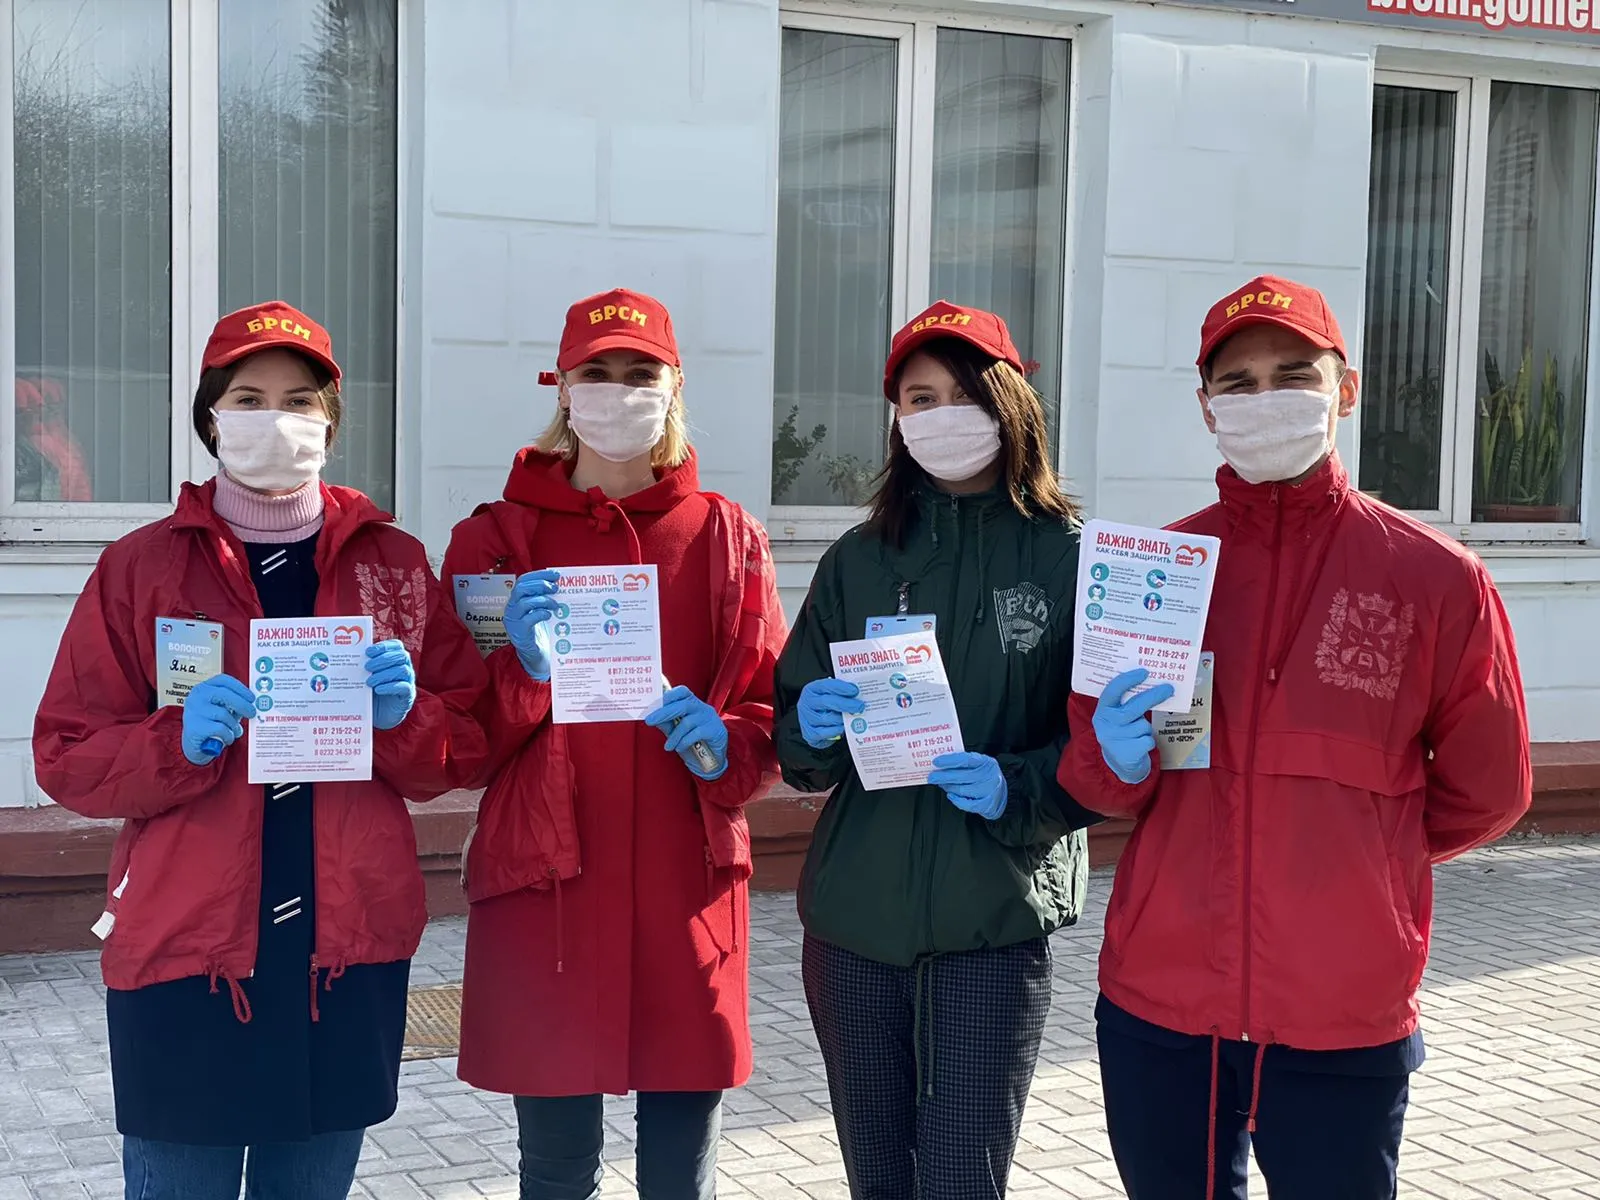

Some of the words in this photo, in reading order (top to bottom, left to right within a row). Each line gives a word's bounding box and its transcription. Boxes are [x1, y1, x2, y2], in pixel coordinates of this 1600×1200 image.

[1225, 291, 1293, 318] БРСМ
[588, 305, 648, 327] БРСМ
[911, 313, 972, 333] БРСМ
[246, 317, 311, 341] БРСМ
[1097, 532, 1135, 549] ВАЖНО
[1137, 539, 1171, 555] ЗНАТЬ
[1130, 552, 1172, 563] ЗАЩИТИТЬ
[589, 574, 617, 585] ЗНАТЬ
[258, 628, 294, 640] ВАЖНО
[297, 627, 328, 638] ЗНАТЬ
[1102, 626, 1129, 638] ТЕЛЕФОНЫ
[1130, 630, 1145, 639] МОГУТ
[1146, 633, 1157, 641] ВАМ
[838, 653, 869, 667] ВАЖНО
[871, 649, 900, 662] ЗНАТЬ
[1157, 649, 1189, 660] 215-22-67
[169, 659, 197, 673] Яна
[869, 662, 904, 671] ЗАЩИТИТЬ
[1144, 659, 1159, 668] 0232
[1160, 661, 1186, 670] 34-57-44
[1158, 672, 1184, 681] 34-53-83
